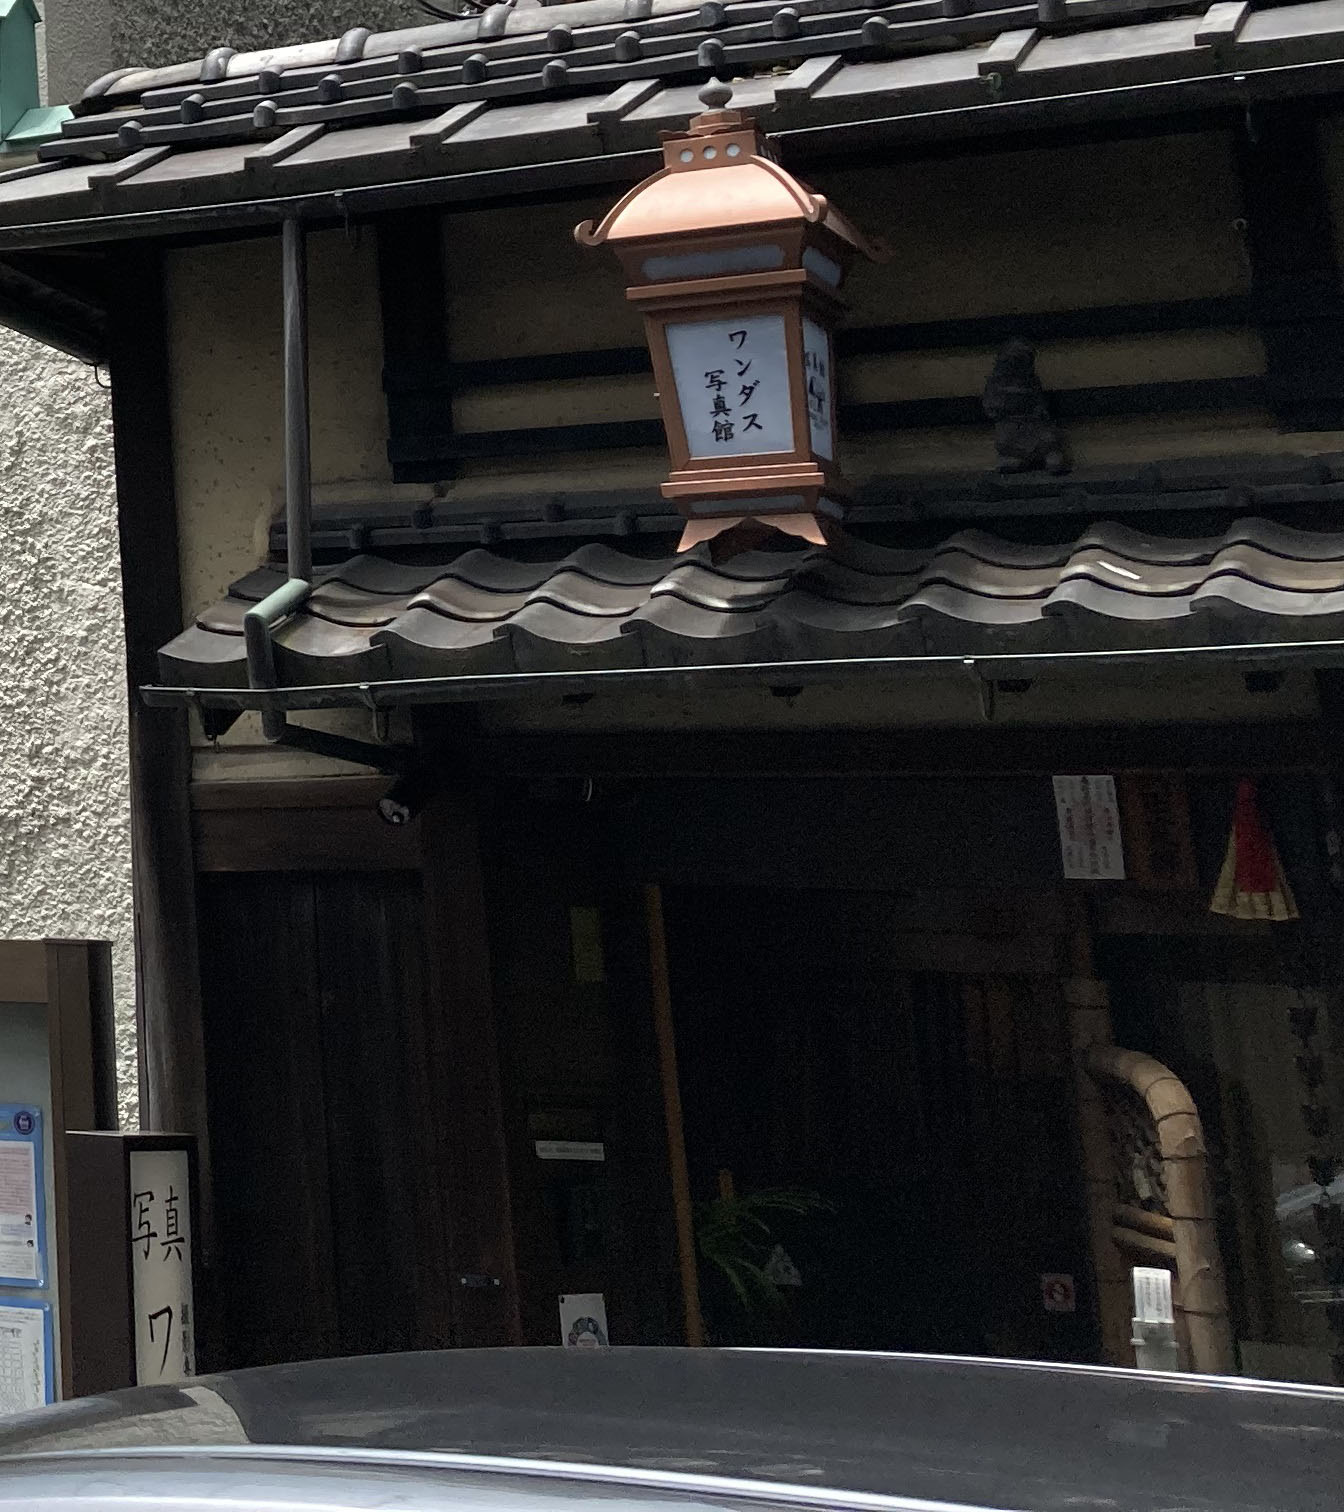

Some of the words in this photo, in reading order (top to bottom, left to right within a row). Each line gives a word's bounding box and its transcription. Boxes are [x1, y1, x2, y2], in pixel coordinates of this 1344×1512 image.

[704, 368, 734, 443] 写真館
[728, 329, 763, 433] ワンダス
[132, 1185, 185, 1262] 写真
[148, 1305, 173, 1376] ワ
